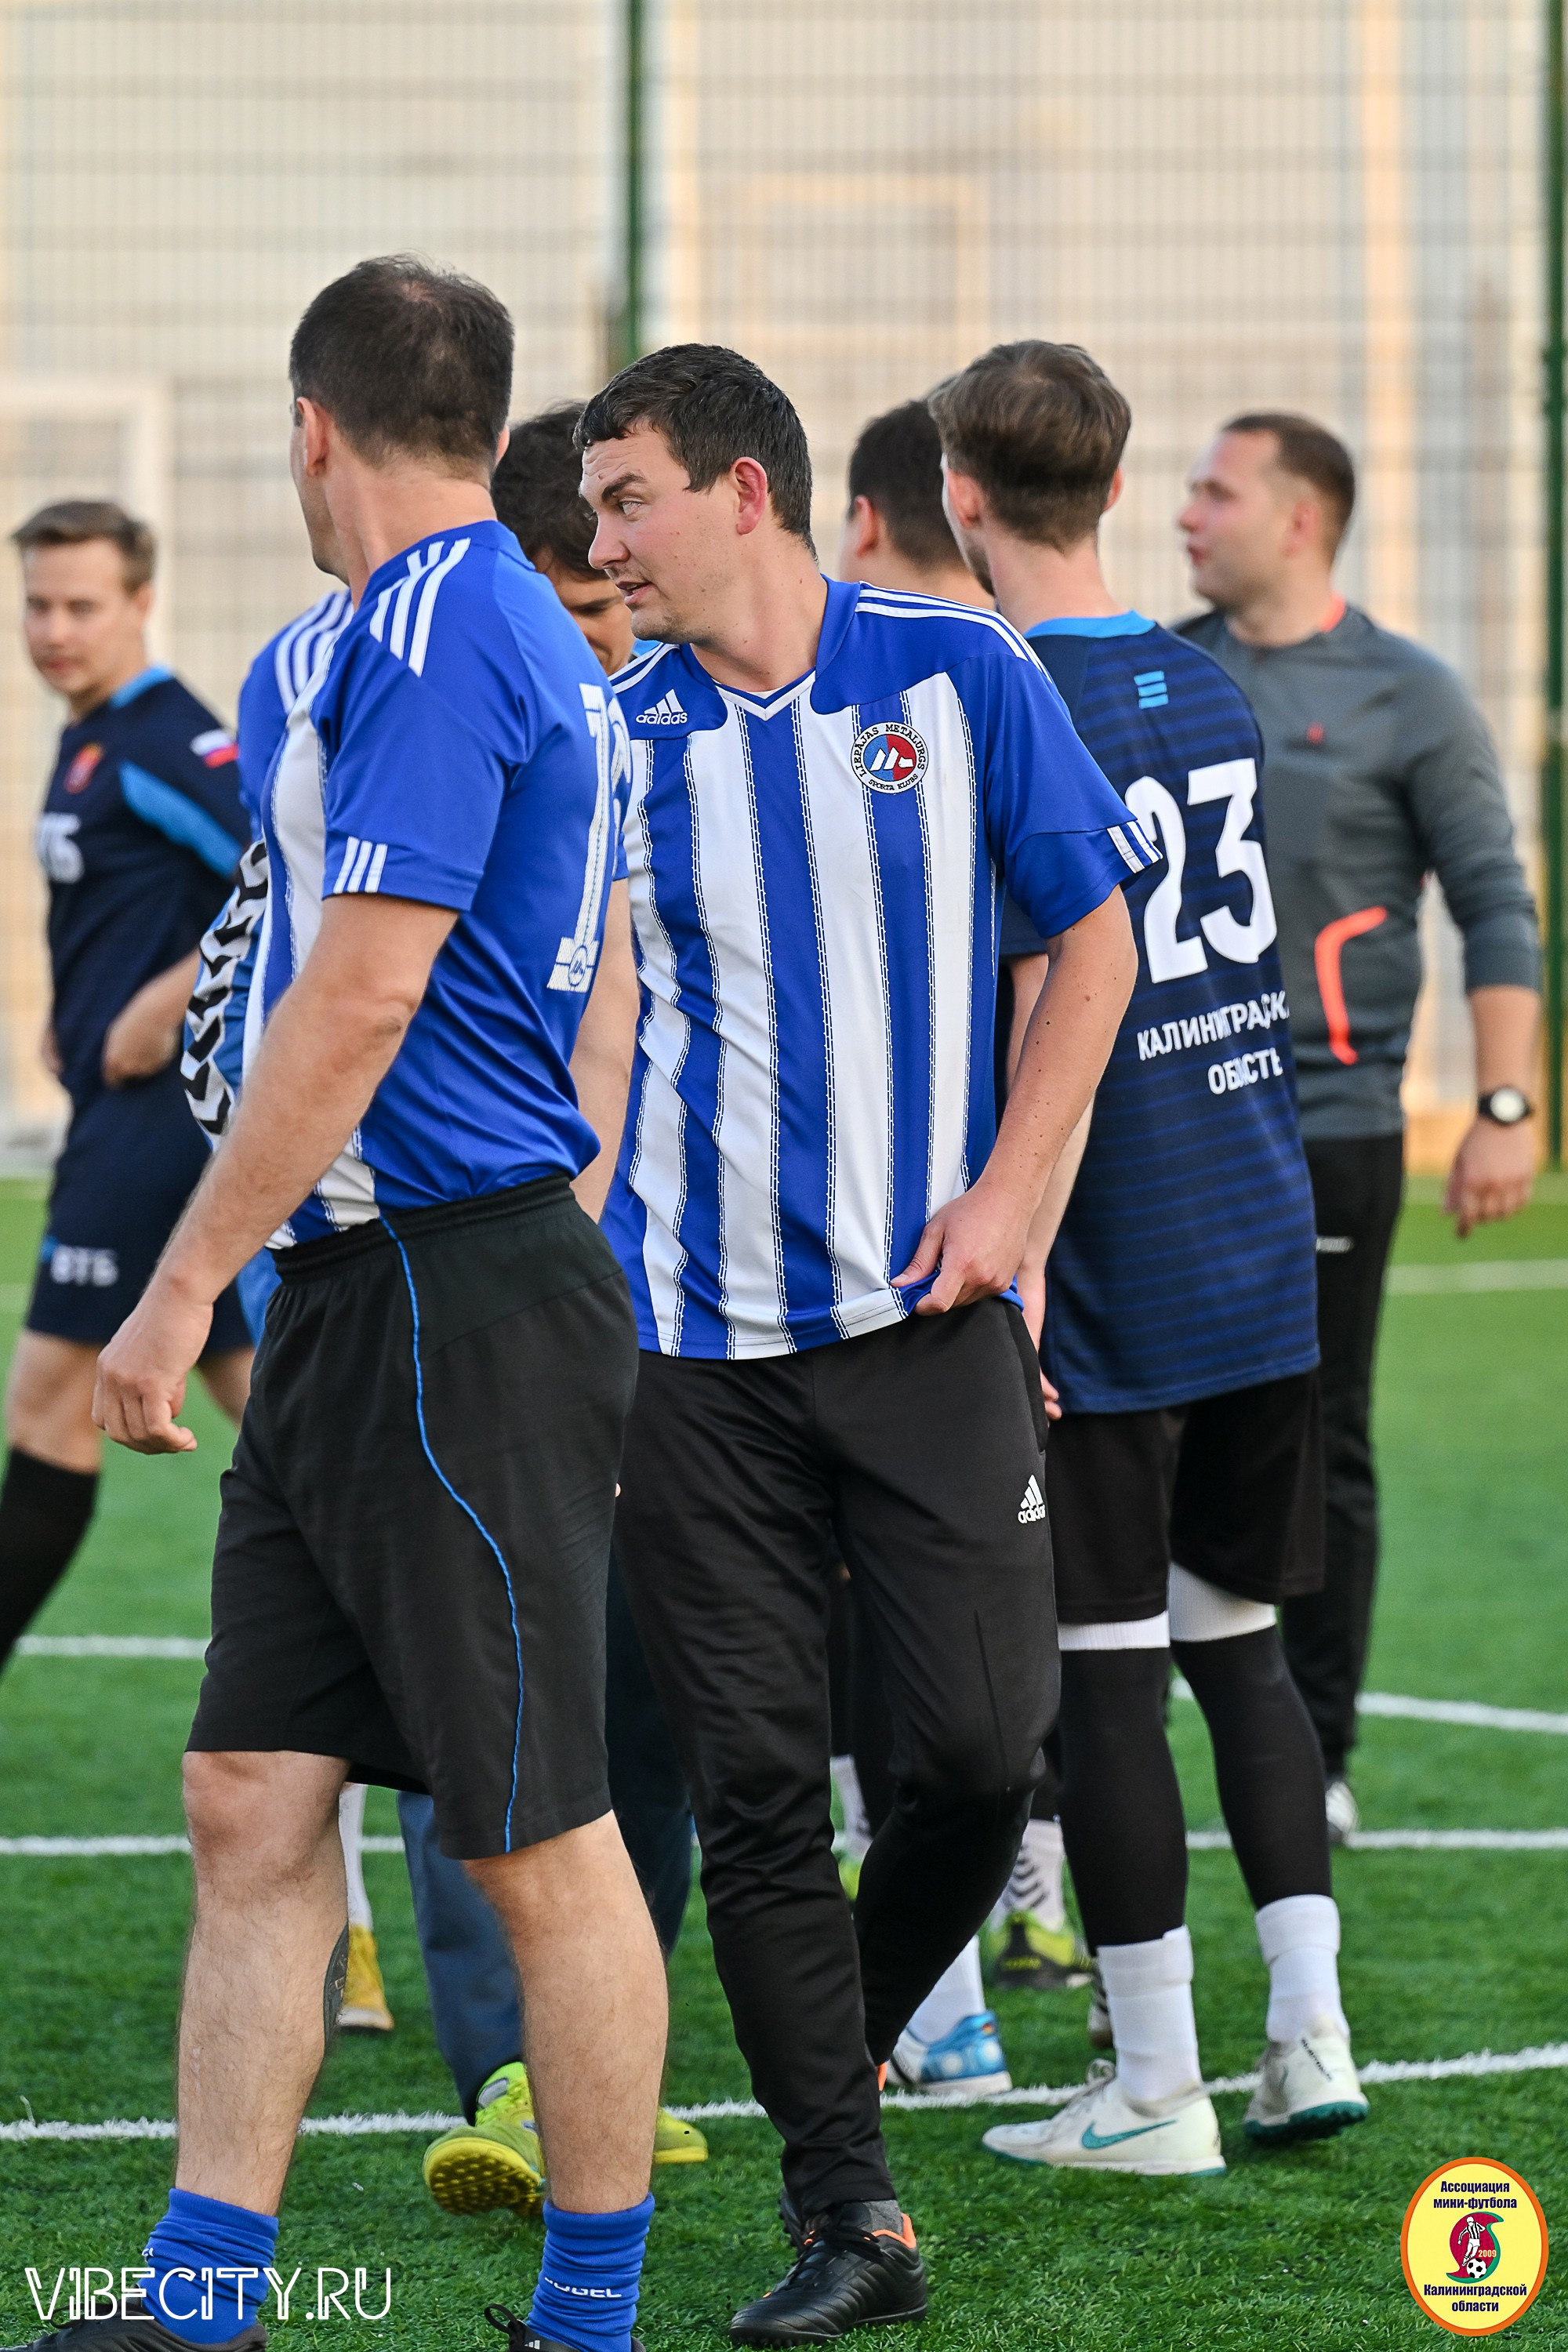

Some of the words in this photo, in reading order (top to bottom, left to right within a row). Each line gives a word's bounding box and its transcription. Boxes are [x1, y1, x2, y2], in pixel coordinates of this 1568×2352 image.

[635, 712, 688, 725] adidas
[885, 724, 926, 770] METALURGS
[869, 779, 895, 790] SPORTA
[898, 774, 918, 789] KLUBS
[1125, 757, 1277, 984] 23
